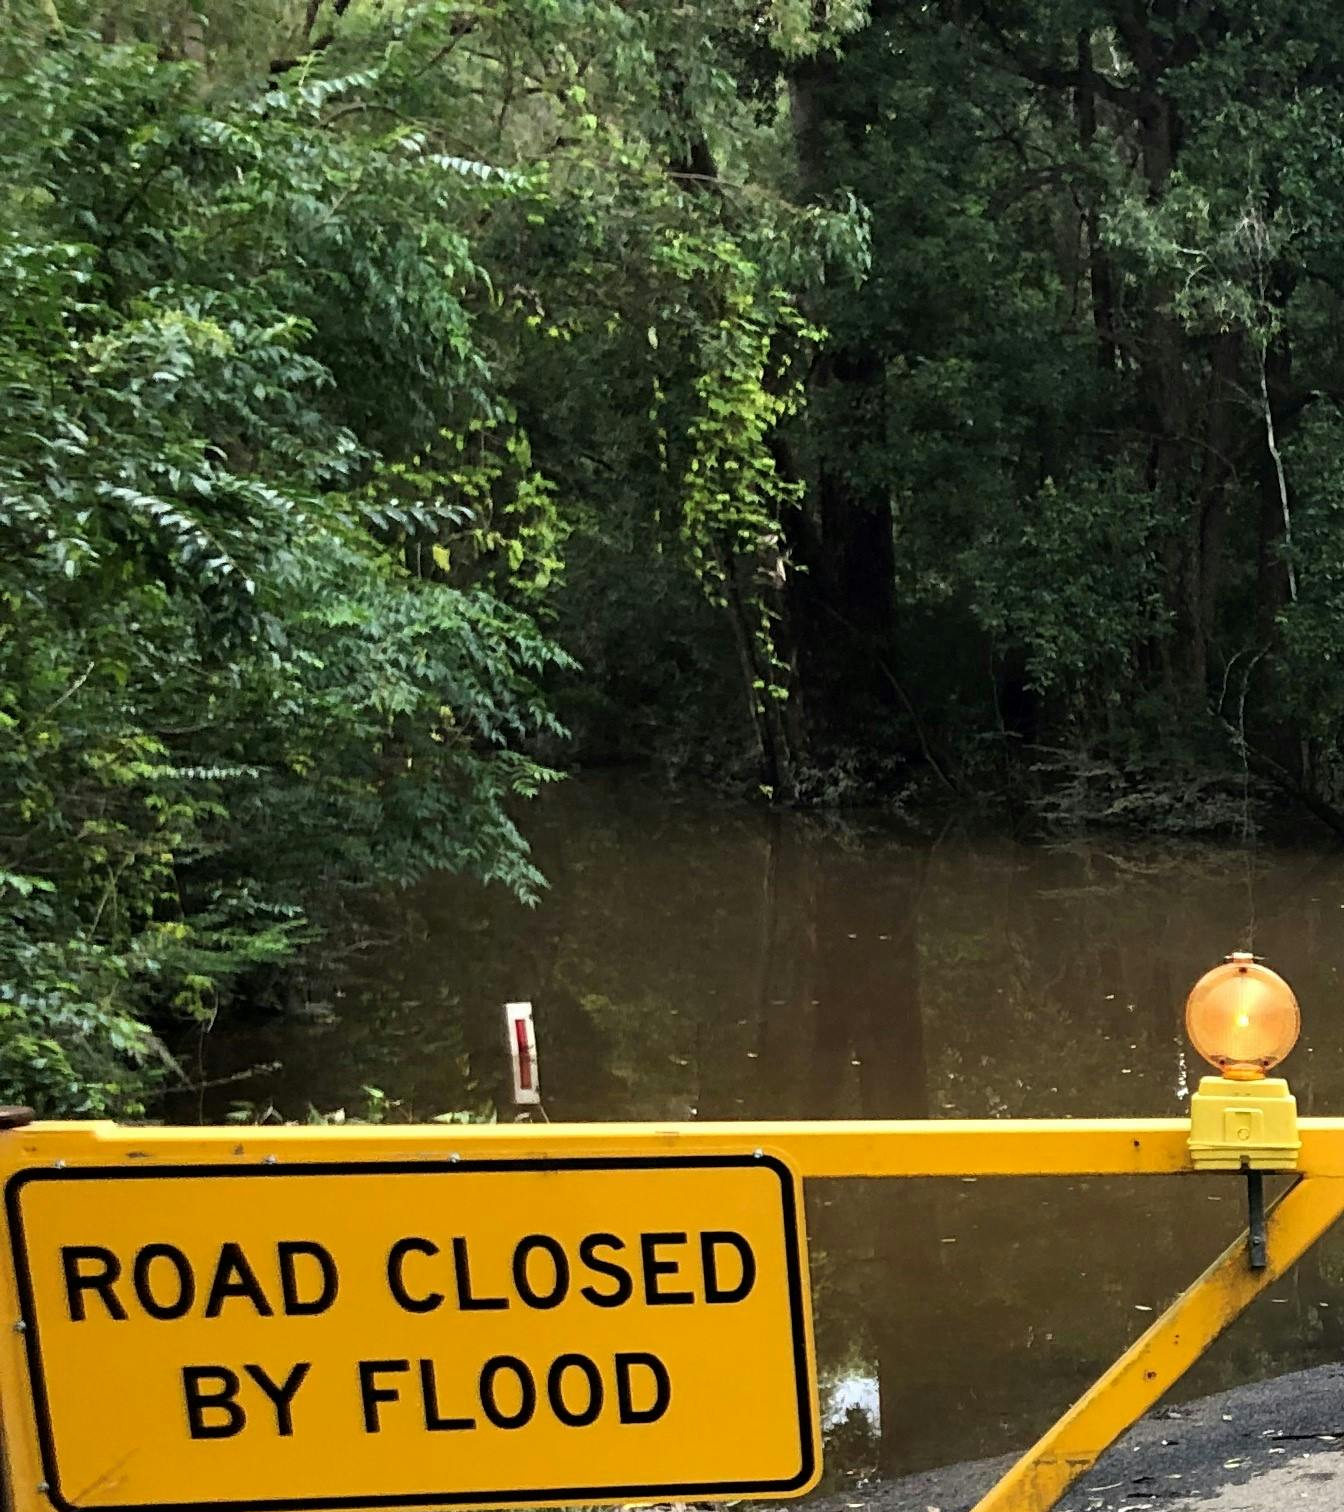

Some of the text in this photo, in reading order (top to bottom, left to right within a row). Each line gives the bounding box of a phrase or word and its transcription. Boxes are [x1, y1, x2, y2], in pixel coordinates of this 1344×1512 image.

[60, 1232, 755, 1322] ROAD CLOSED
[182, 1353, 670, 1439] BY FLOOD
